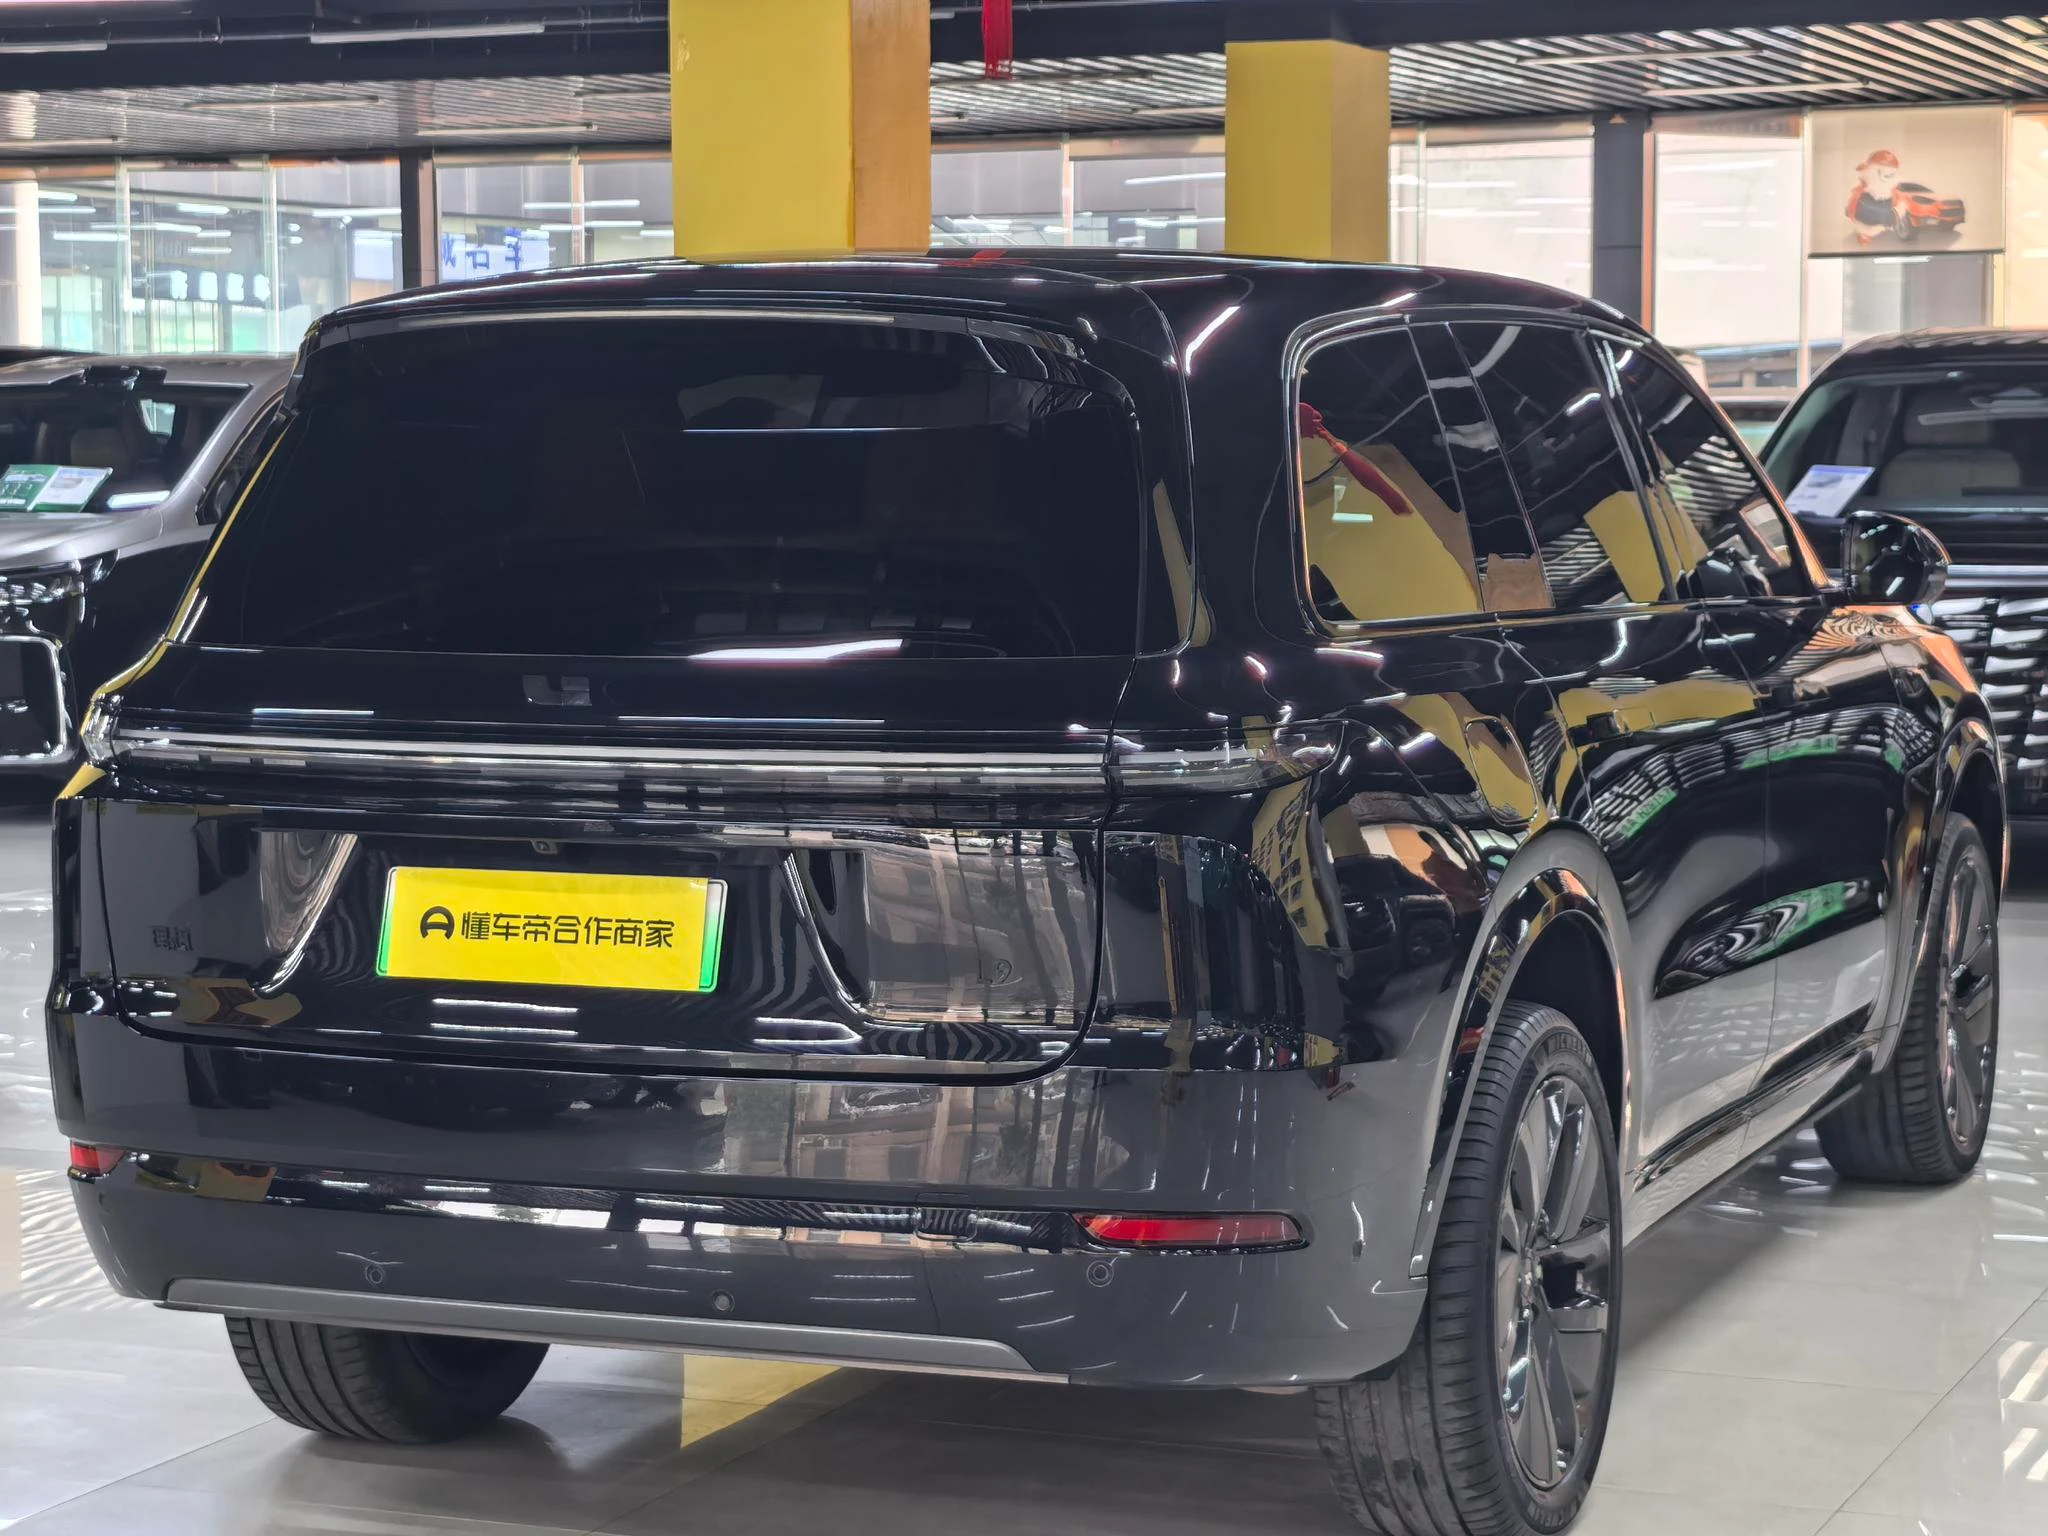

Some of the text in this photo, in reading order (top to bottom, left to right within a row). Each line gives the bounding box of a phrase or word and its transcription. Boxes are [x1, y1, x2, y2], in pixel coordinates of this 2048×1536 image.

[461, 911, 675, 948] 懂车帝合作商家
